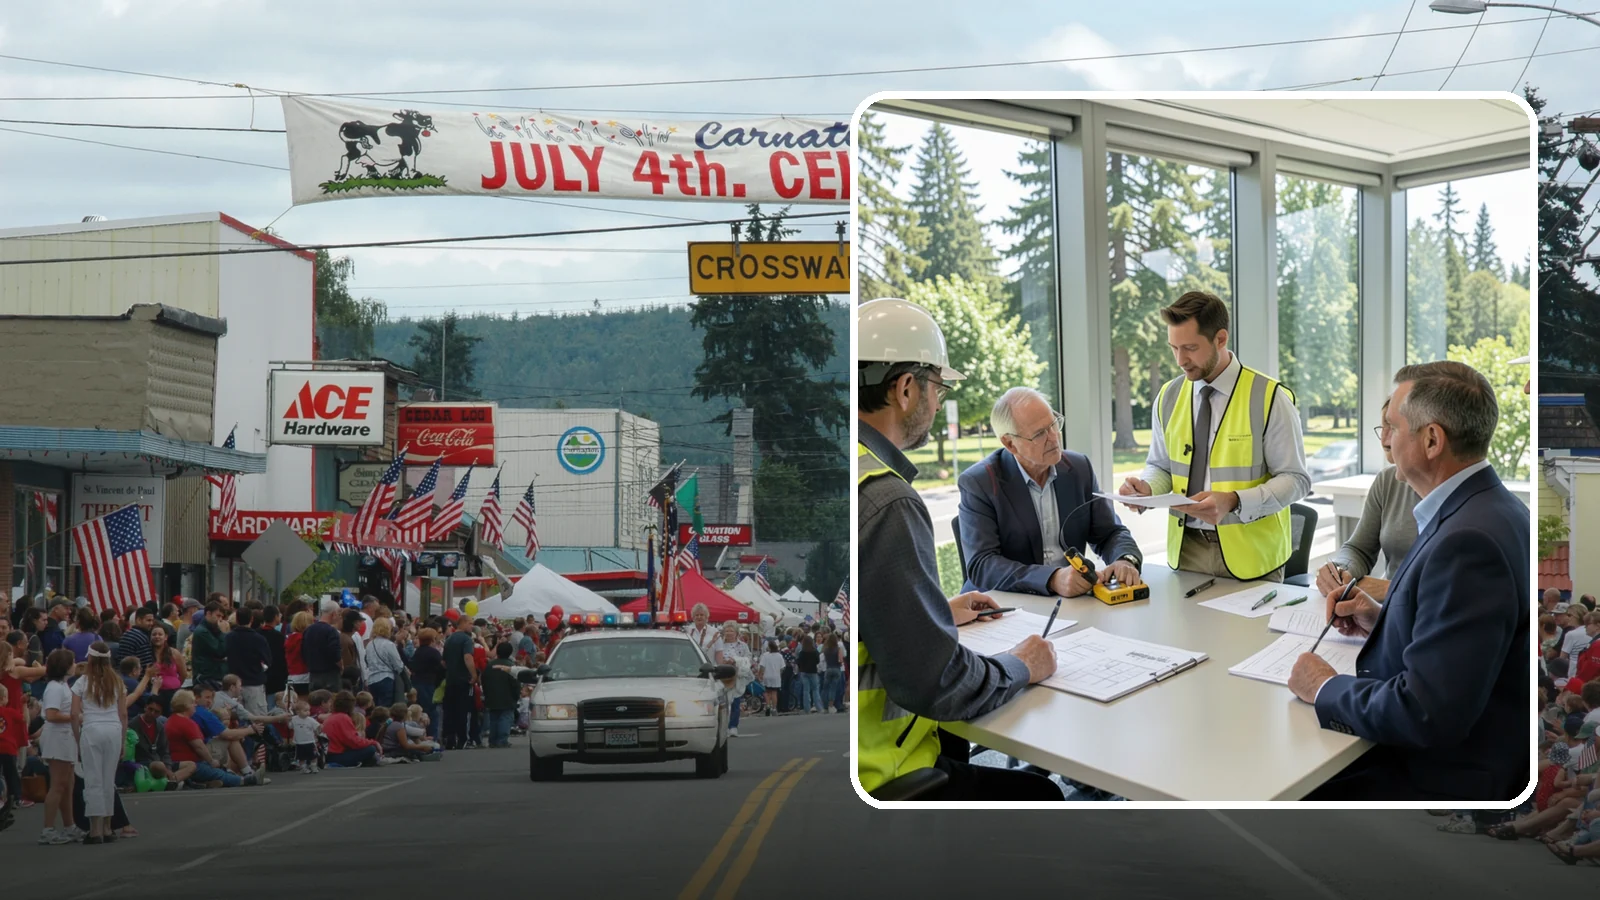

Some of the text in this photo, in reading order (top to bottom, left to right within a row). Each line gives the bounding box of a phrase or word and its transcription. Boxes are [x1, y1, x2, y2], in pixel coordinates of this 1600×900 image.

[695, 121, 850, 149] Carnat
[481, 141, 605, 192] JULY
[632, 150, 746, 198] 4th.
[697, 254, 850, 280] CROSSWA
[283, 380, 373, 420] ACE
[405, 409, 452, 422] CEDAR
[284, 421, 371, 436] Hardware
[416, 428, 477, 447] Coca-Cola
[96, 484, 124, 495] Vincent
[126, 486, 135, 495] de
[138, 486, 155, 495] Paul
[688, 527, 742, 535] CRNATION
[699, 535, 730, 543] GLASS
